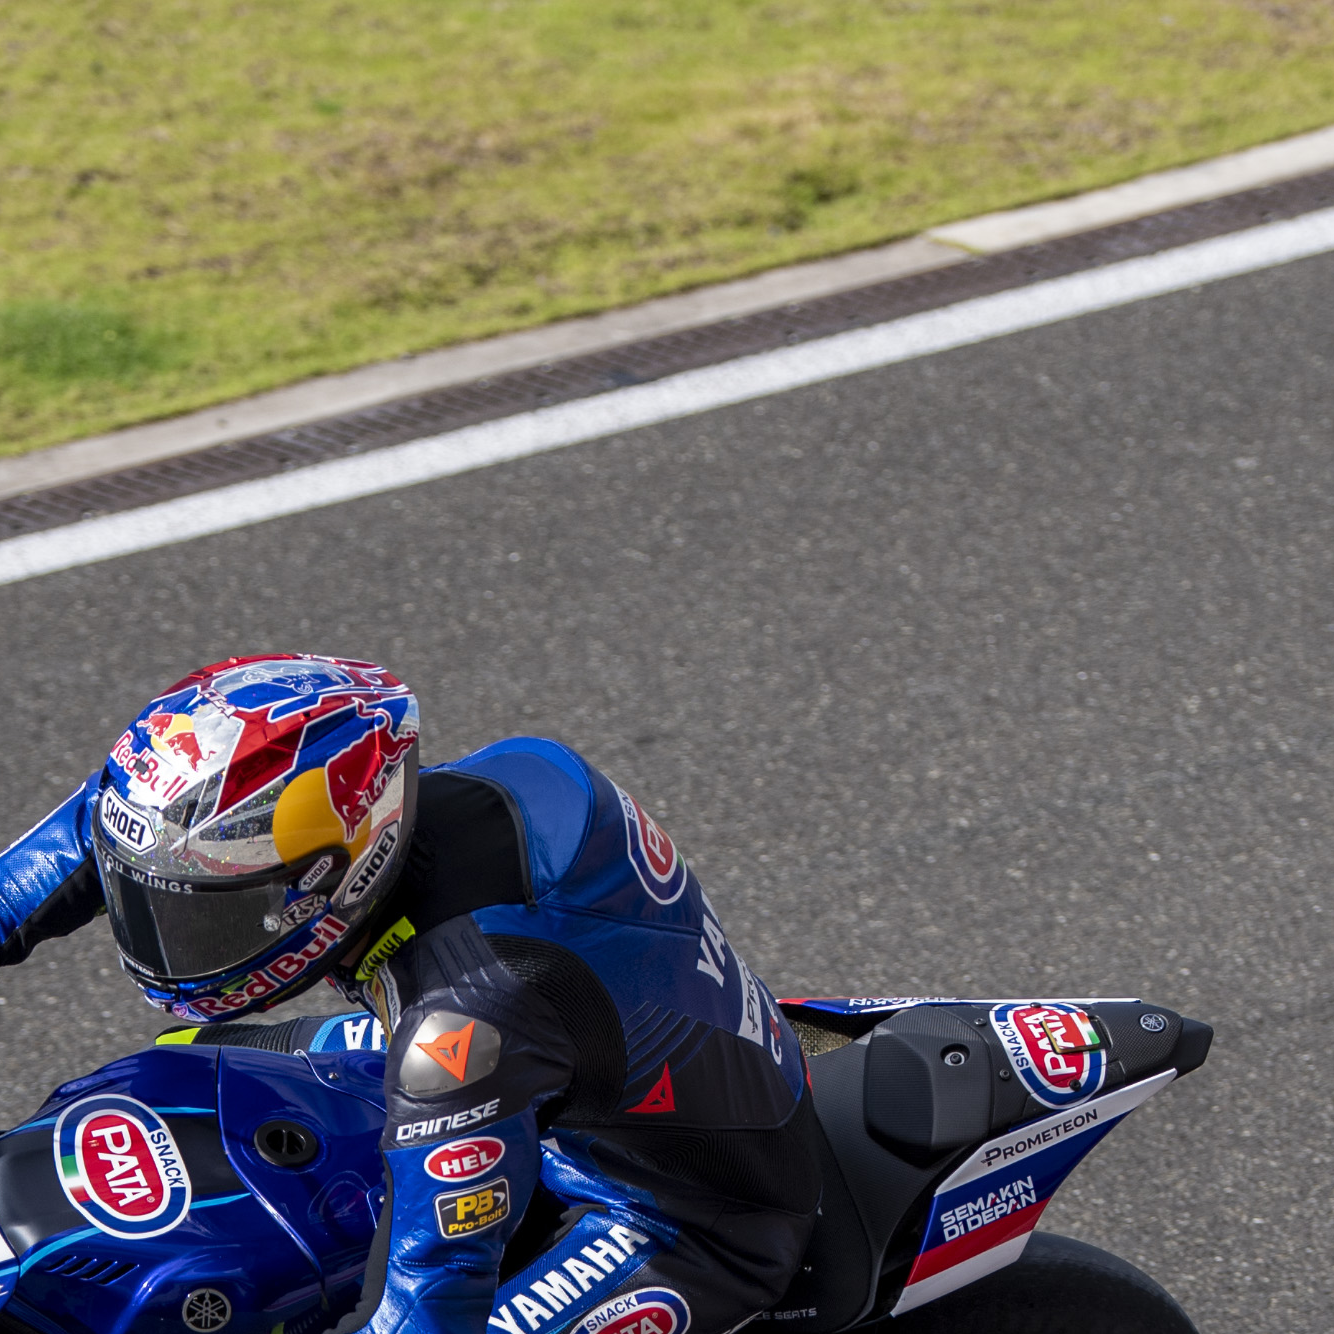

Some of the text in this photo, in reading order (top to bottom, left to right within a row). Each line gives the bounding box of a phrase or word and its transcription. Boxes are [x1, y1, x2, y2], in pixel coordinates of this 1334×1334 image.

[104, 797, 145, 847] SHOEI
[100, 847, 193, 894] YOU WINGS
[303, 860, 329, 888] SHOEI
[350, 831, 397, 898] SHOEI
[189, 970, 281, 1017] Red
[267, 913, 350, 983] Bull
[359, 932, 404, 977] YAMAHA
[998, 1022, 1030, 1071] SNACK
[396, 1099, 500, 1141] DAINESE
[981, 1109, 1098, 1166] PROMETEON
[91, 1124, 152, 1208] PATA
[149, 1129, 185, 1188] SNACK
[441, 1148, 495, 1176] HEL
[448, 1206, 505, 1234] Pro-Bolt
[456, 1189, 495, 1221] PB
[941, 1175, 1034, 1227] SEMAKIN
[943, 1189, 1037, 1242] DI DEPAN
[586, 1297, 637, 1332] SNACK
[774, 1307, 817, 1320] SEATS
